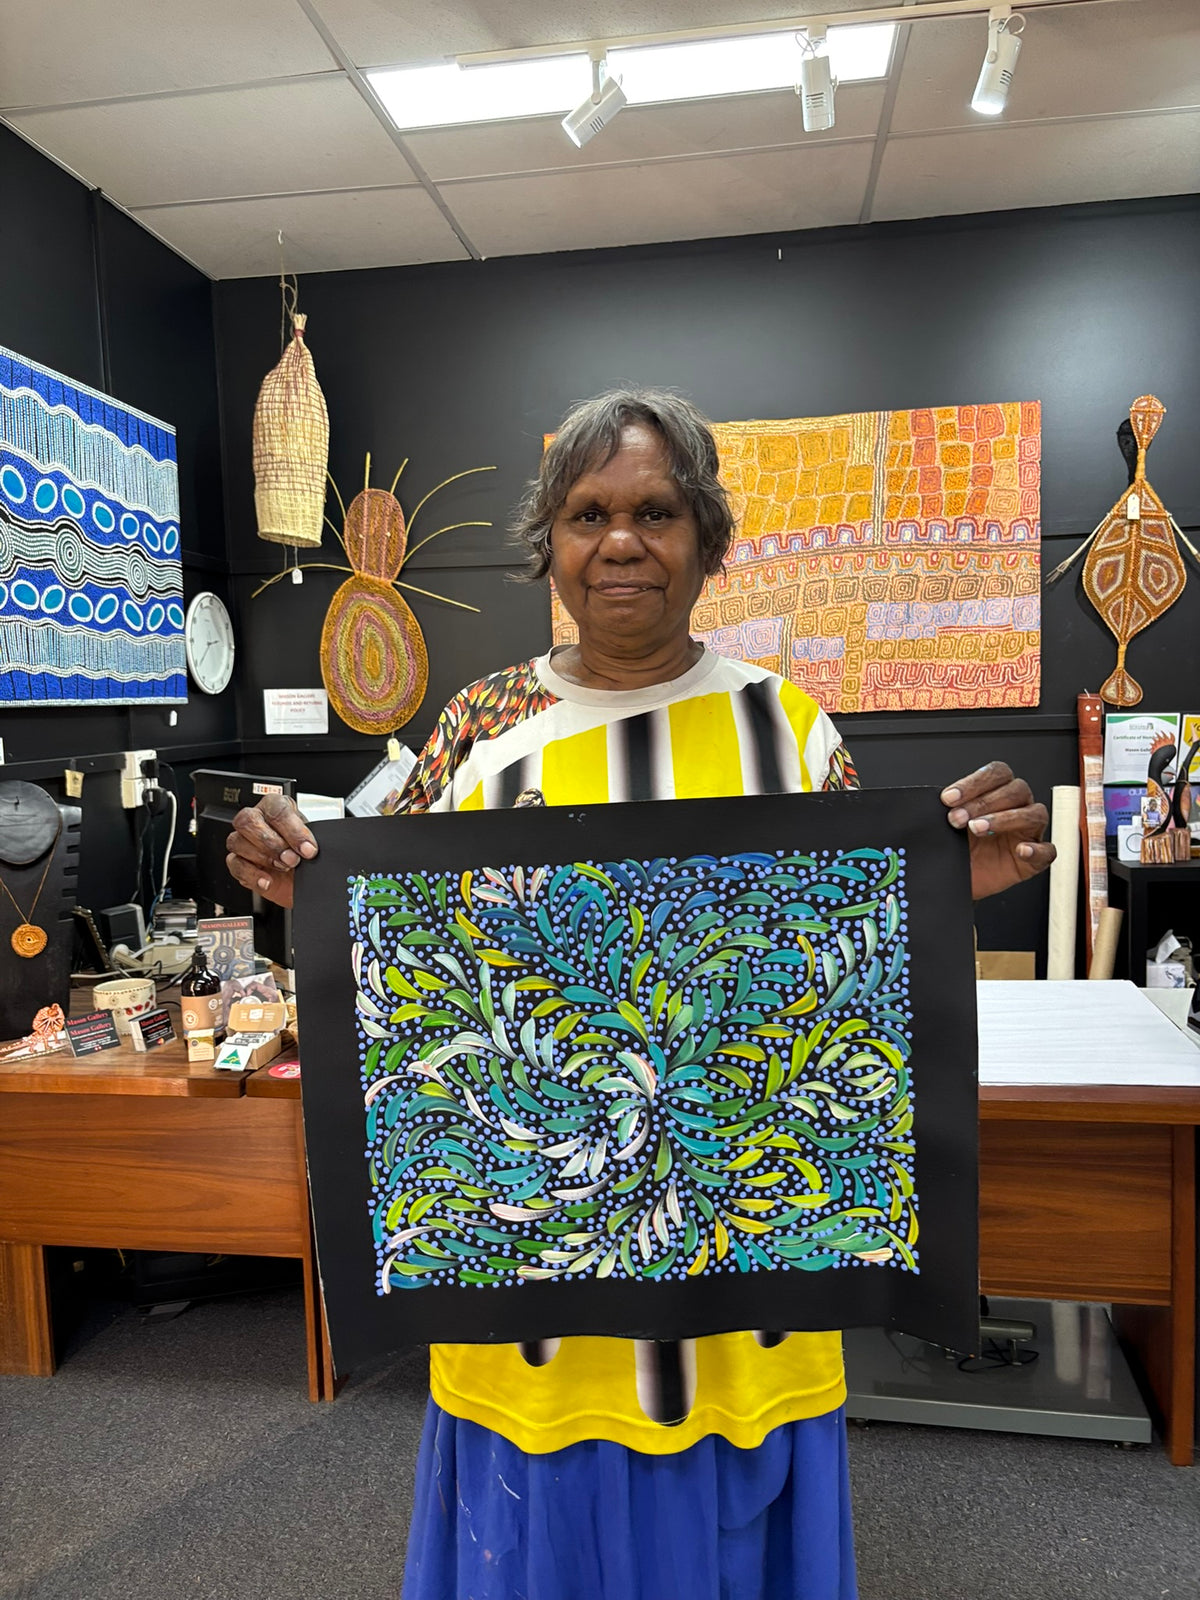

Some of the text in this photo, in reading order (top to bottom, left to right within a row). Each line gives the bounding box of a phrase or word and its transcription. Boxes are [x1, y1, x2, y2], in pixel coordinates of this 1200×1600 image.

[67, 1013, 108, 1026] Mason Gallery
[154, 1013, 168, 1021] Gallery
[70, 1028, 90, 1036] Mason
[90, 1022, 112, 1031] Gallery
